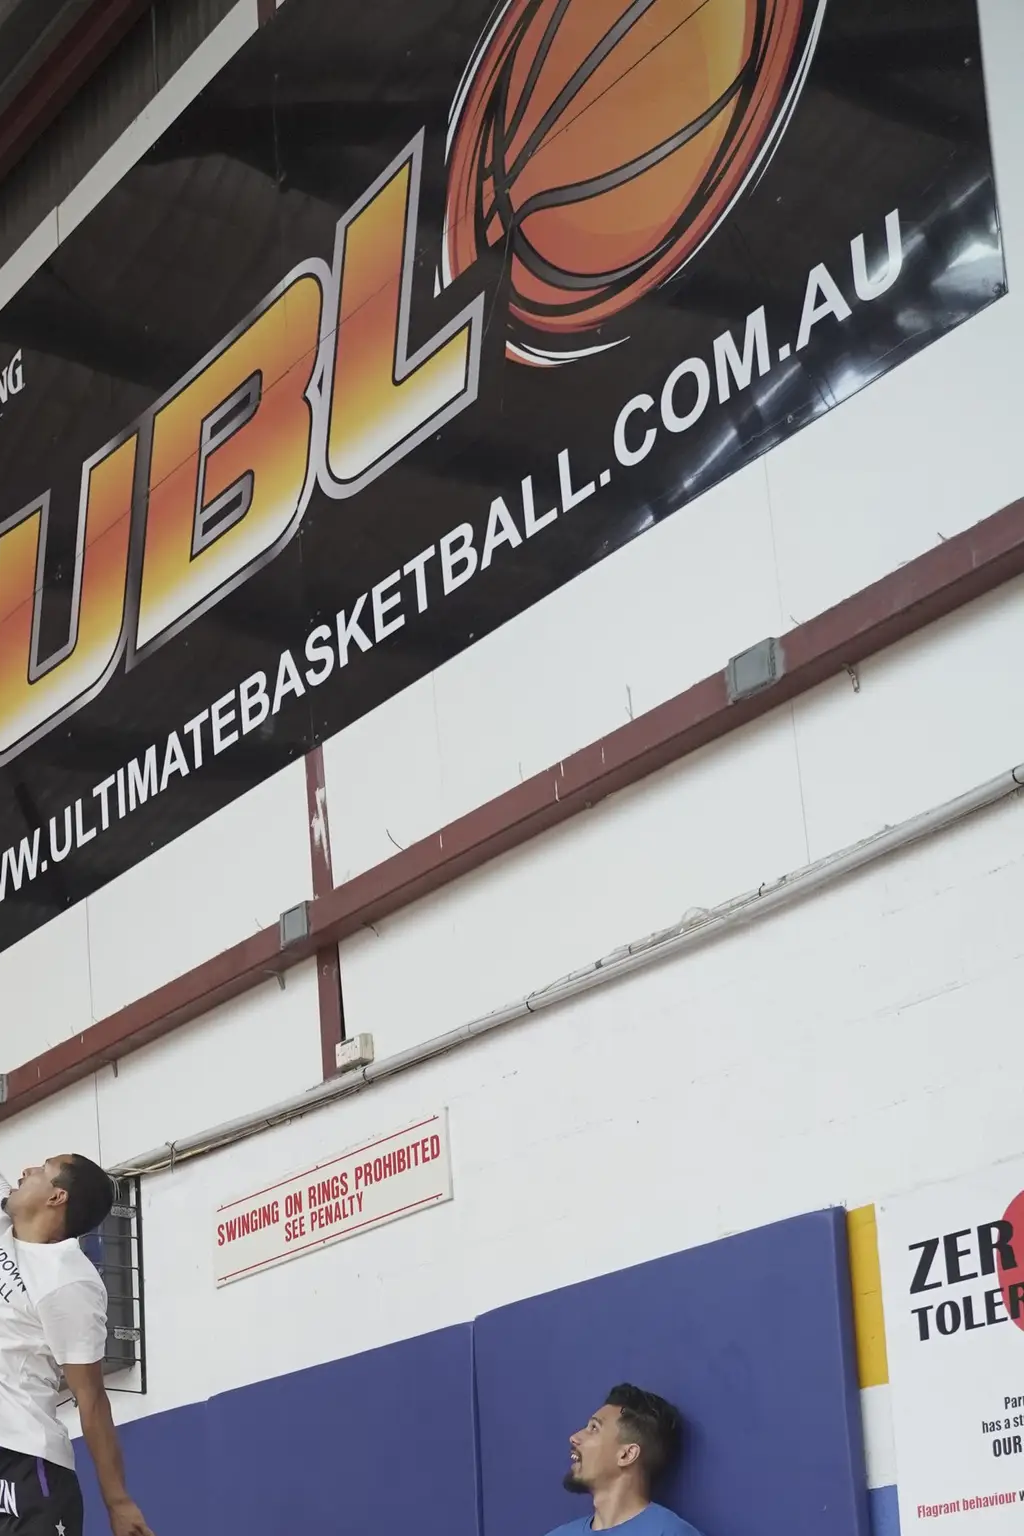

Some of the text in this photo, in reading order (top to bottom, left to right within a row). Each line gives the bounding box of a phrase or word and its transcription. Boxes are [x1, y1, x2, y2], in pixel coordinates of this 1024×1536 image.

[216, 1134, 441, 1247] SWINGING ON RINGS PROHIBITED
[284, 1191, 365, 1243] SEE PENALTY
[1004, 1396, 1024, 1410] Par
[982, 1414, 1024, 1434] has a st
[992, 1435, 1022, 1457] OUR
[917, 1500, 961, 1518] Flagrant
[962, 1491, 1017, 1511] behaviour
